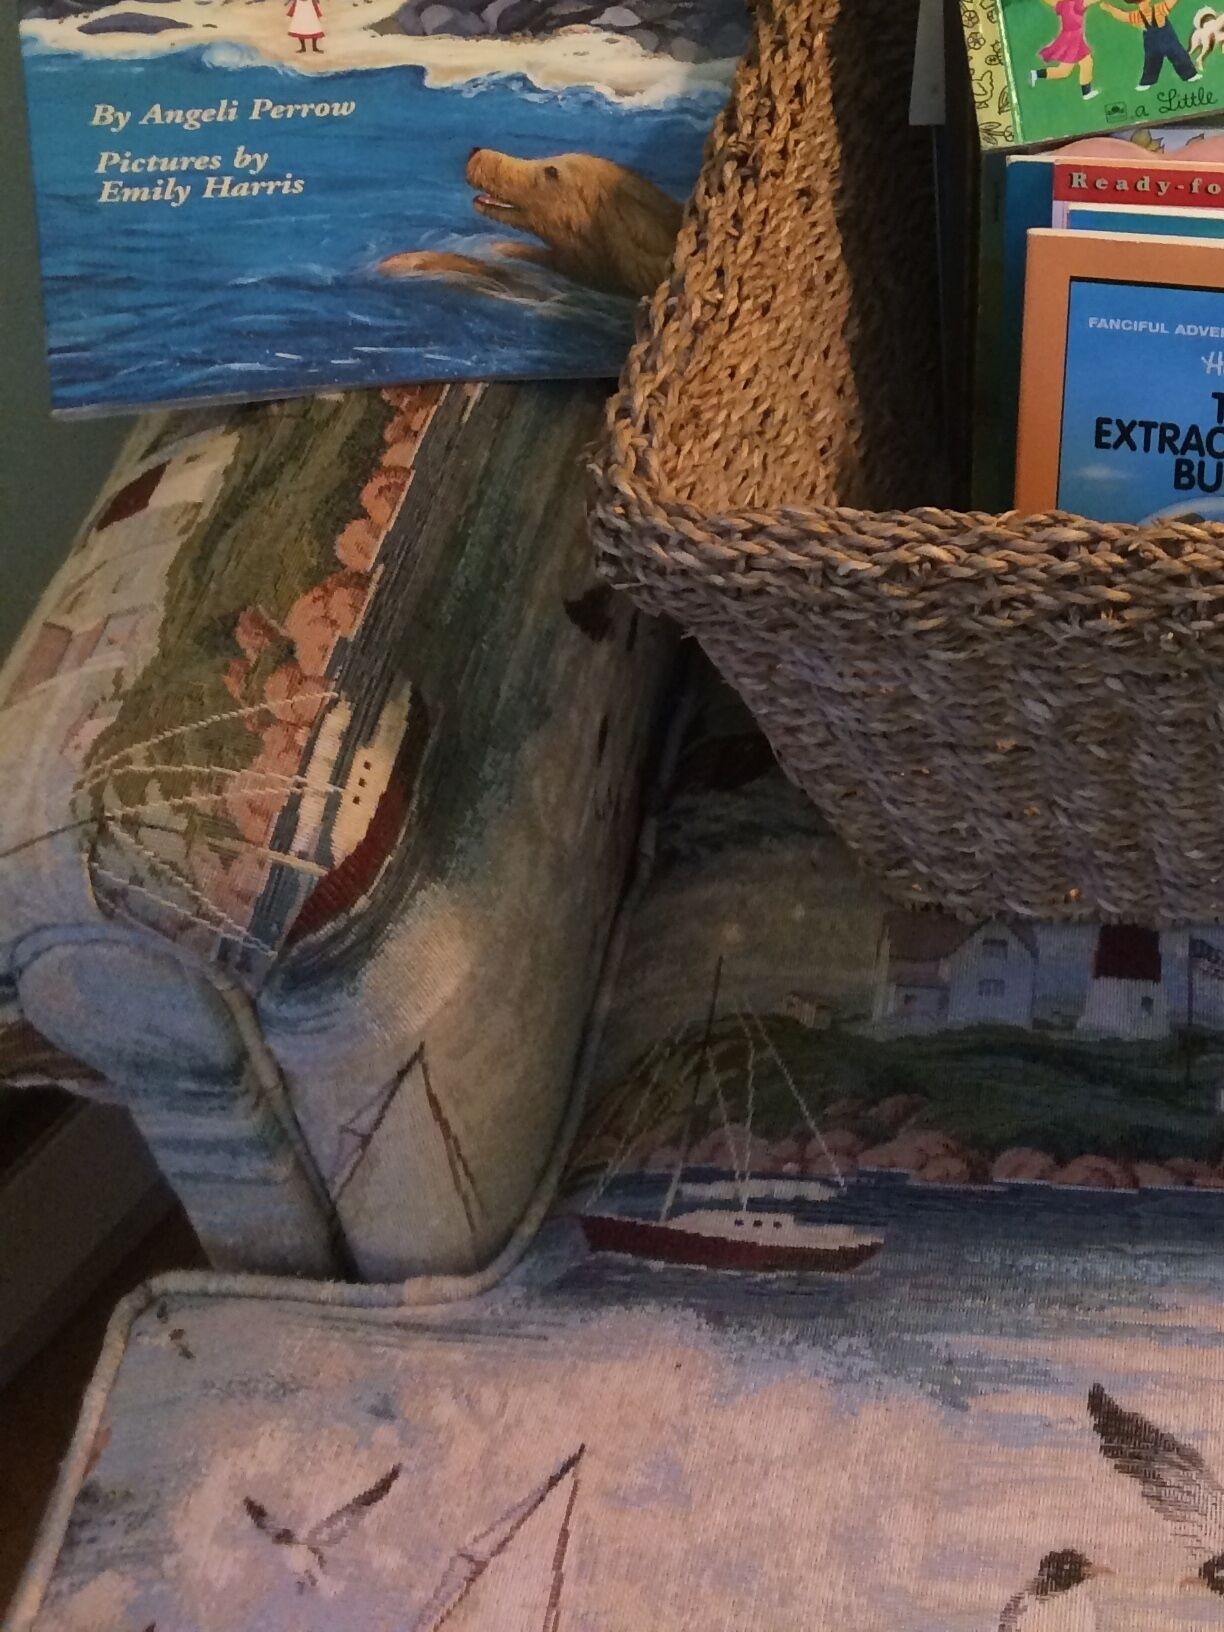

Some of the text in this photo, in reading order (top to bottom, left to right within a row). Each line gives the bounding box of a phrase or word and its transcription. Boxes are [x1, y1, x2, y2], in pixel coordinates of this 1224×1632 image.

[90, 98, 356, 132] By Angeli Perrow
[1135, 105, 1150, 119] a
[1157, 88, 1217, 113] Little
[94, 145, 269, 175] Pictures by
[97, 172, 305, 207] Emily Harris
[1088, 316, 1170, 334] FANCIFUL
